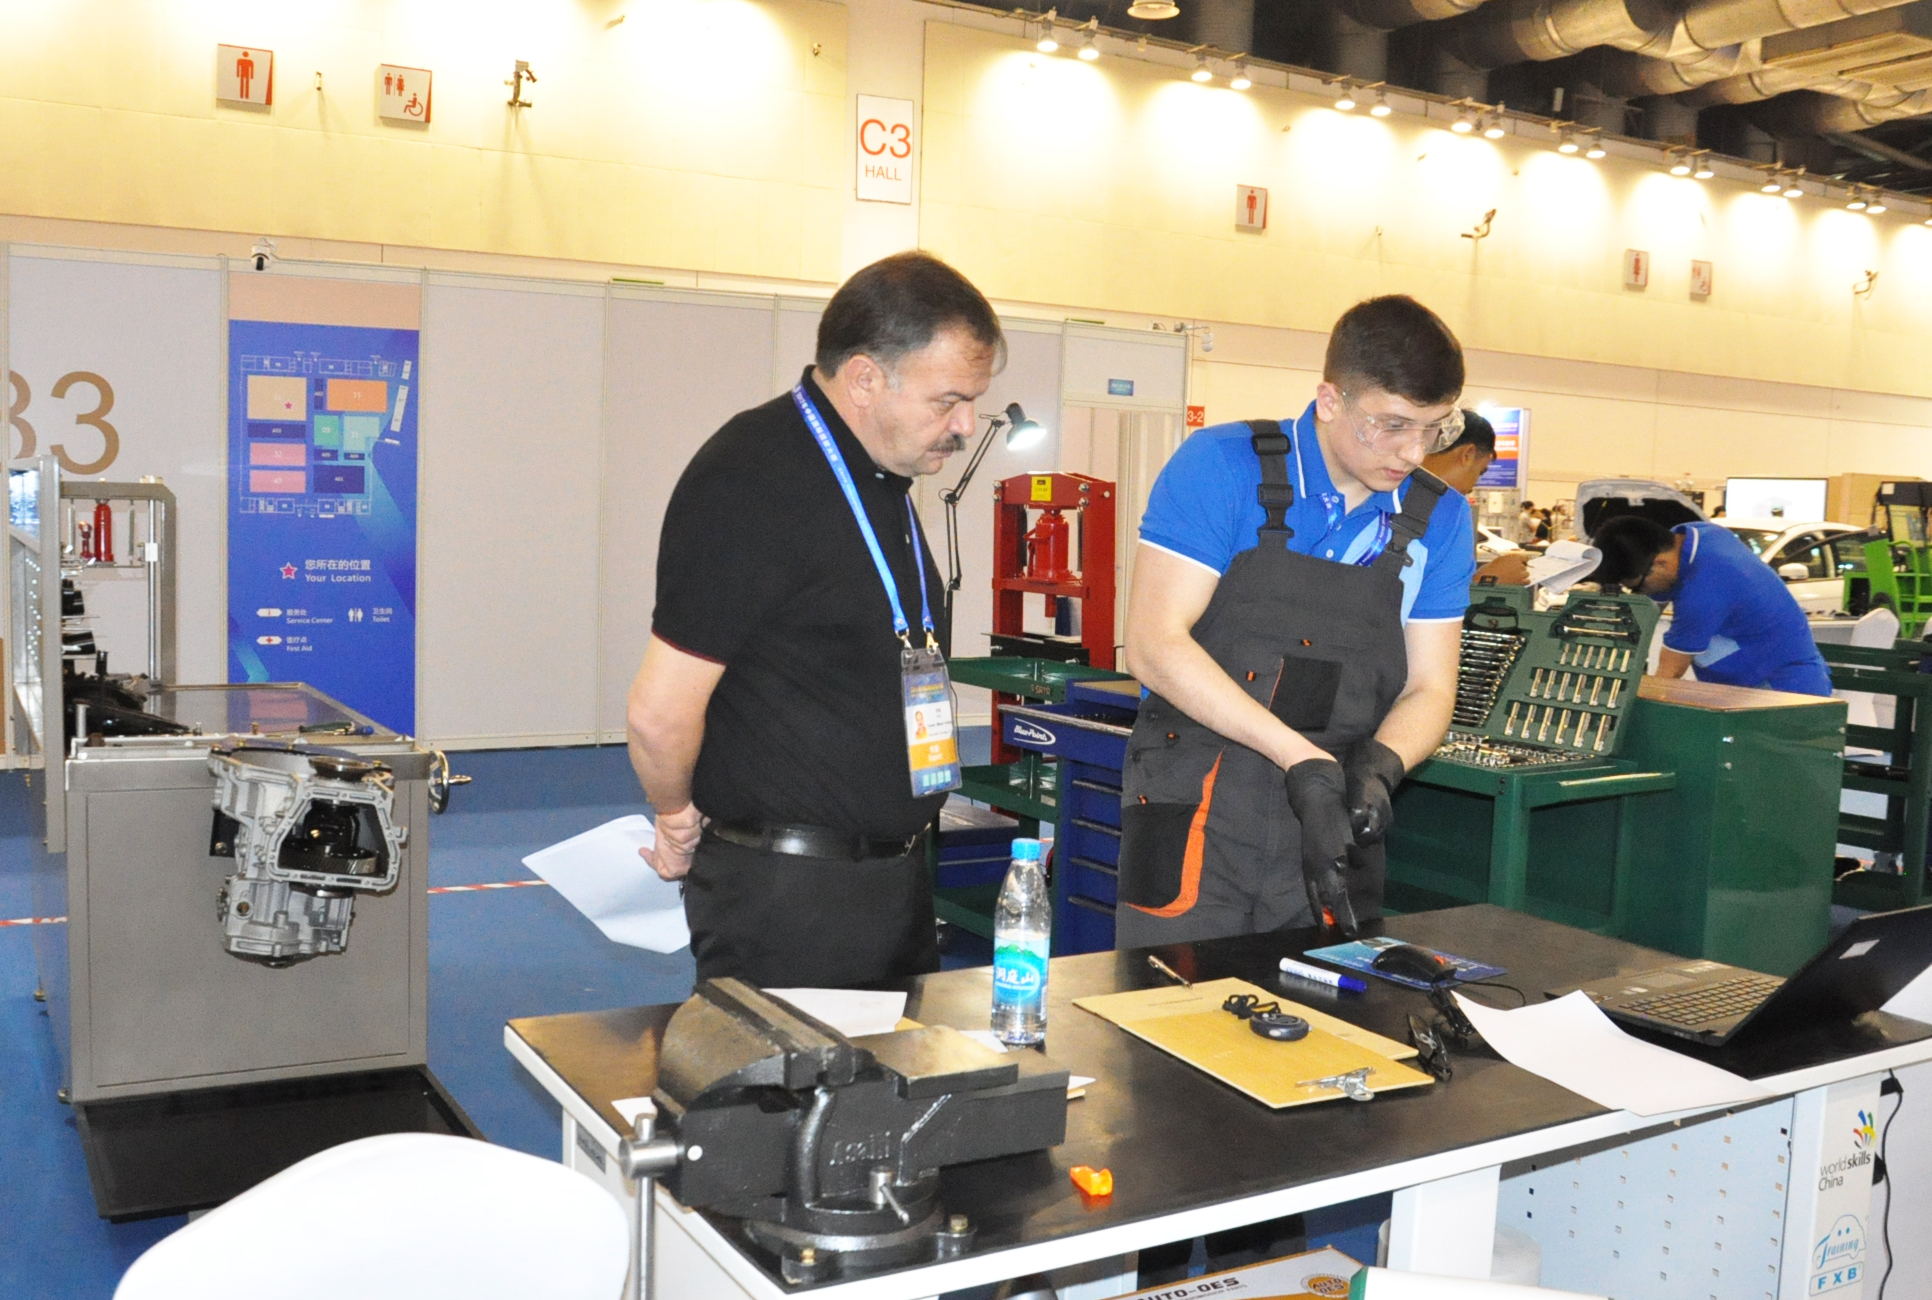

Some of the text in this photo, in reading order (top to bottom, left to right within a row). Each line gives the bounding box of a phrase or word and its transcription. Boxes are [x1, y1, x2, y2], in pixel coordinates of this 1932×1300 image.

[860, 118, 911, 158] C3
[865, 164, 902, 181] HALL
[1187, 410, 1204, 422] 3-2
[305, 559, 371, 570] 您所在的位置
[305, 574, 371, 582] Your Location
[1818, 1175, 1844, 1191] China
